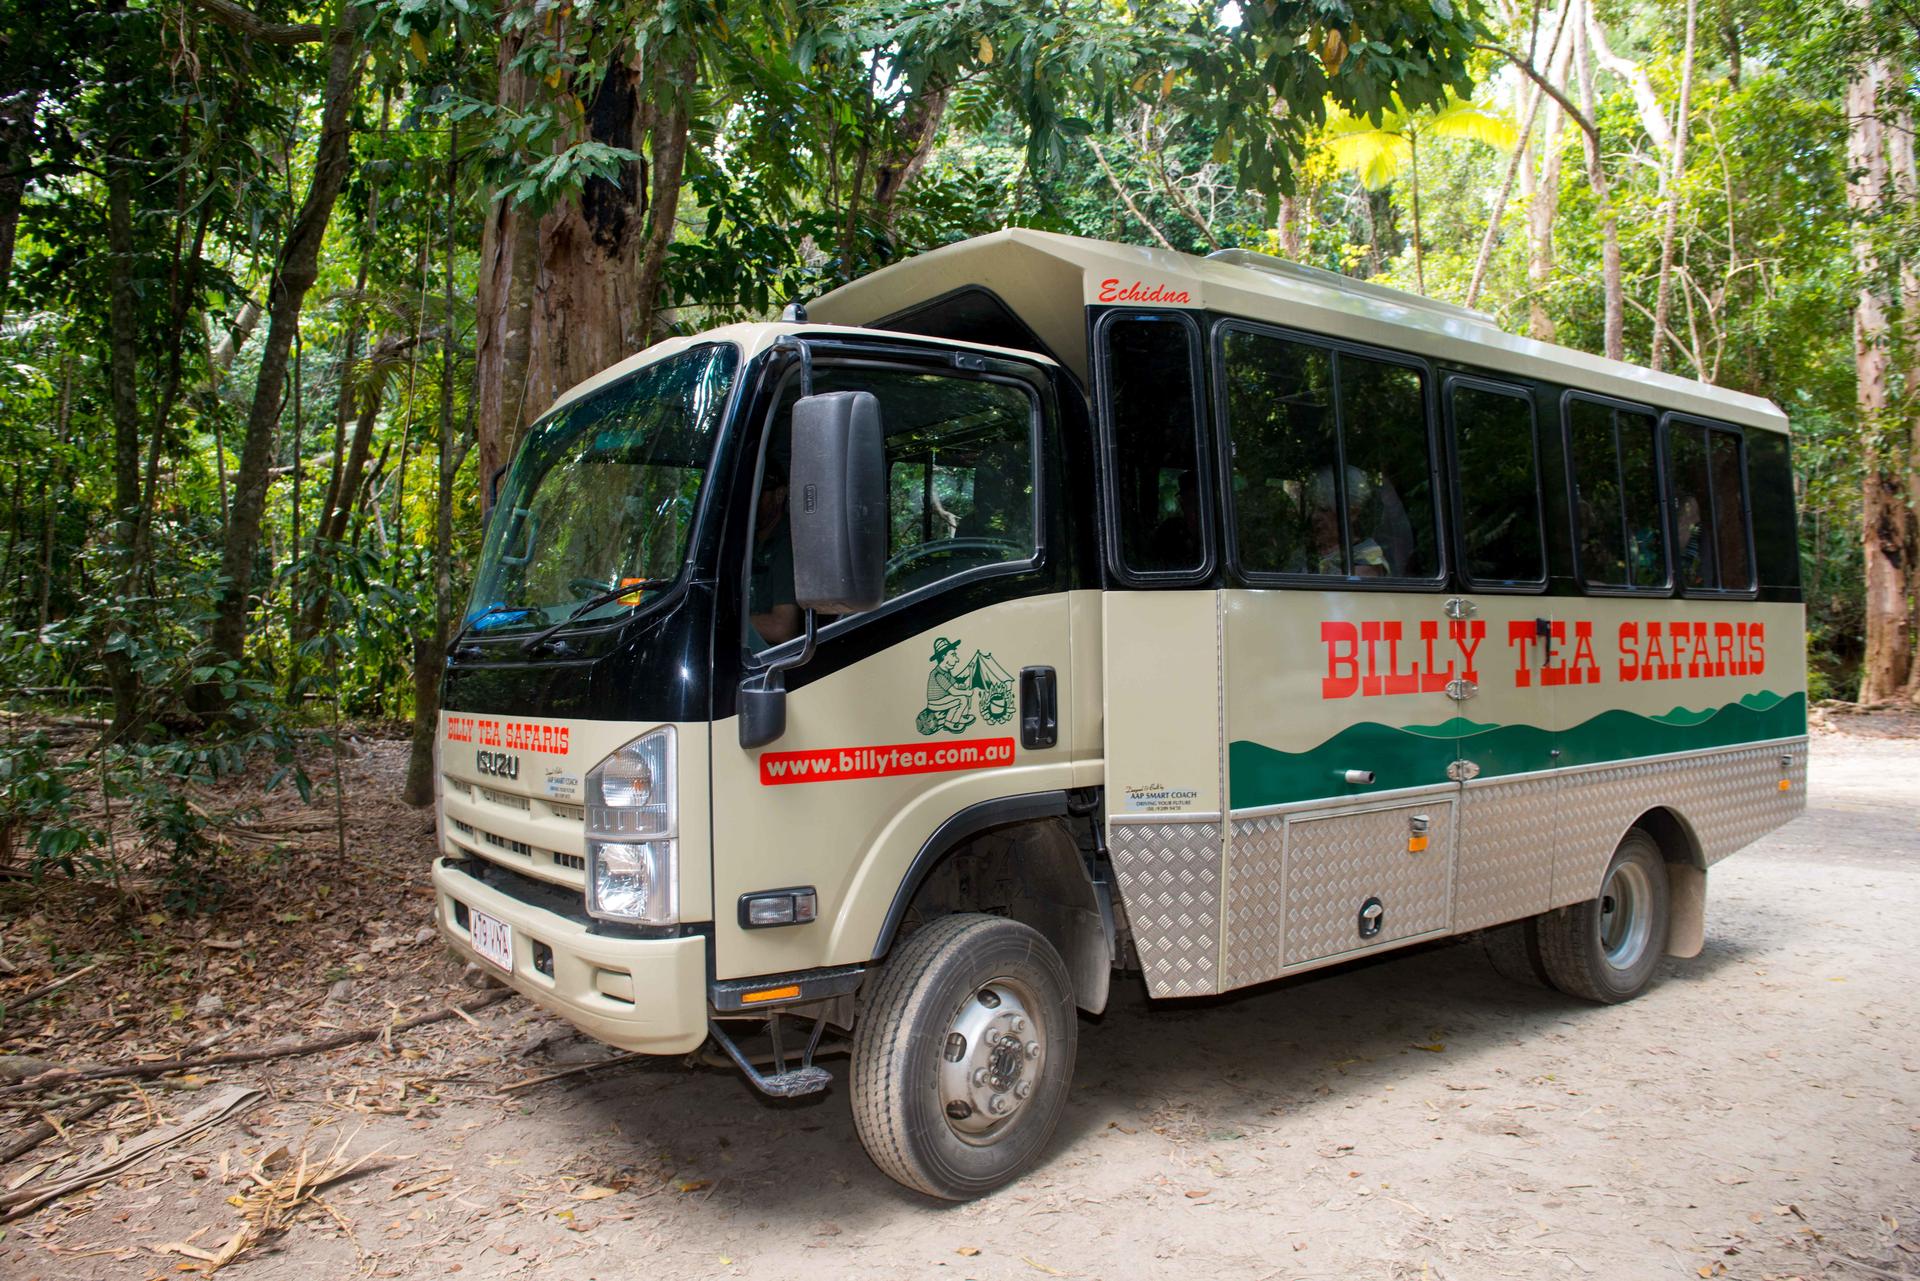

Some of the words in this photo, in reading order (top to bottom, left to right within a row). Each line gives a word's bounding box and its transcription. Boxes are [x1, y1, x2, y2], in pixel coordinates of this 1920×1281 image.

[1098, 279, 1191, 304] Echidna
[1321, 620, 1486, 699] BILLY
[1508, 620, 1601, 688] TEA
[1618, 621, 1765, 683] SAFARIS
[448, 717, 474, 743] BILLY
[478, 719, 502, 747] TEA
[505, 722, 569, 755] SAFARIS
[476, 749, 519, 780] ISUZU
[766, 743, 1011, 778] www.billytea.com.au
